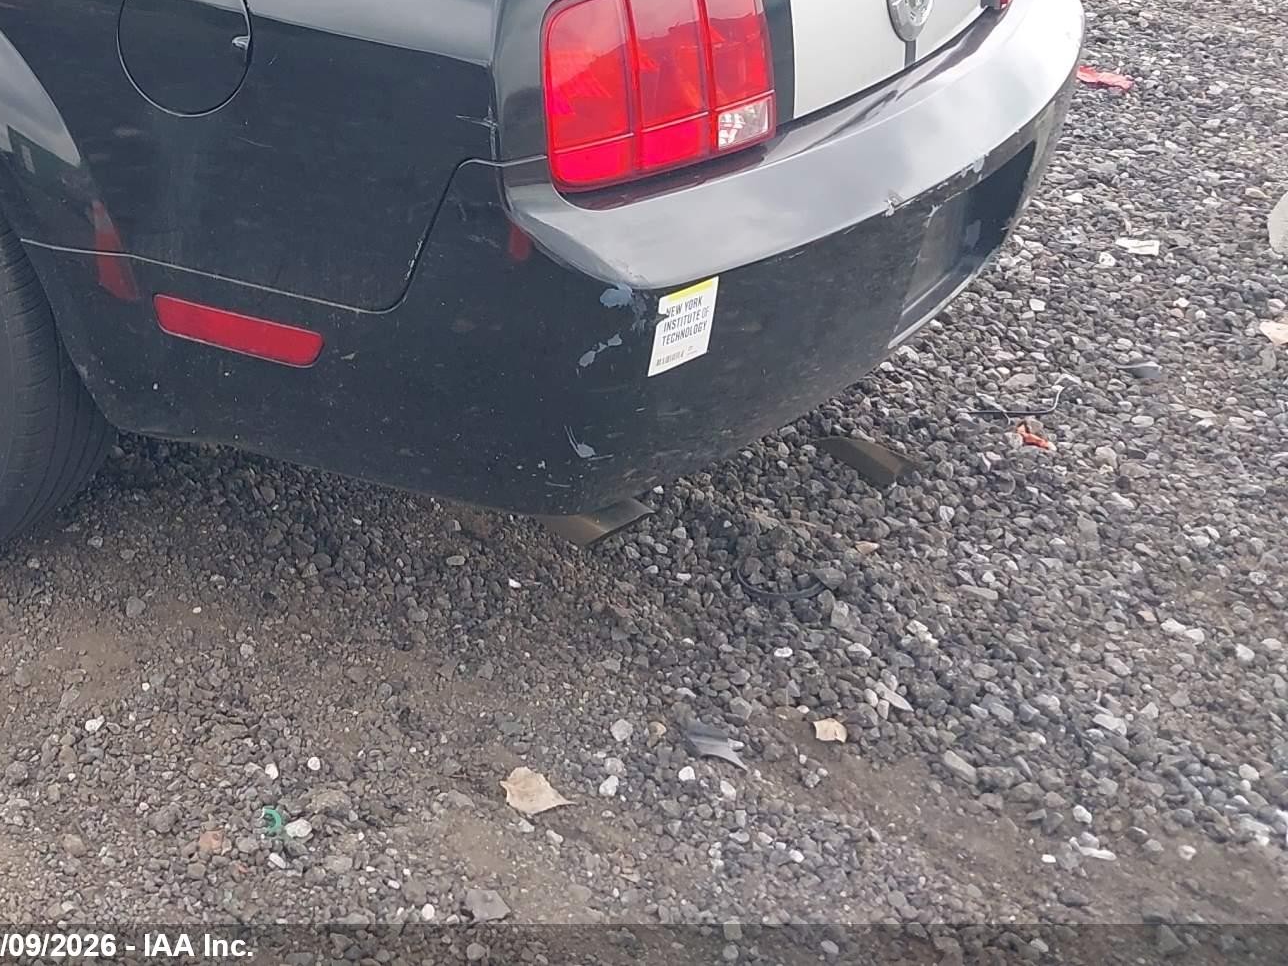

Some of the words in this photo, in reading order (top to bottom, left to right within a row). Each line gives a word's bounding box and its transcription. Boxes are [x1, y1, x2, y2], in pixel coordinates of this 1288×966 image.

[664, 309, 701, 332] INSTITUTE
[702, 306, 710, 318] OF
[666, 303, 682, 317] NEW
[685, 295, 702, 311] YORK
[662, 320, 707, 346] TECHNOLOGY
